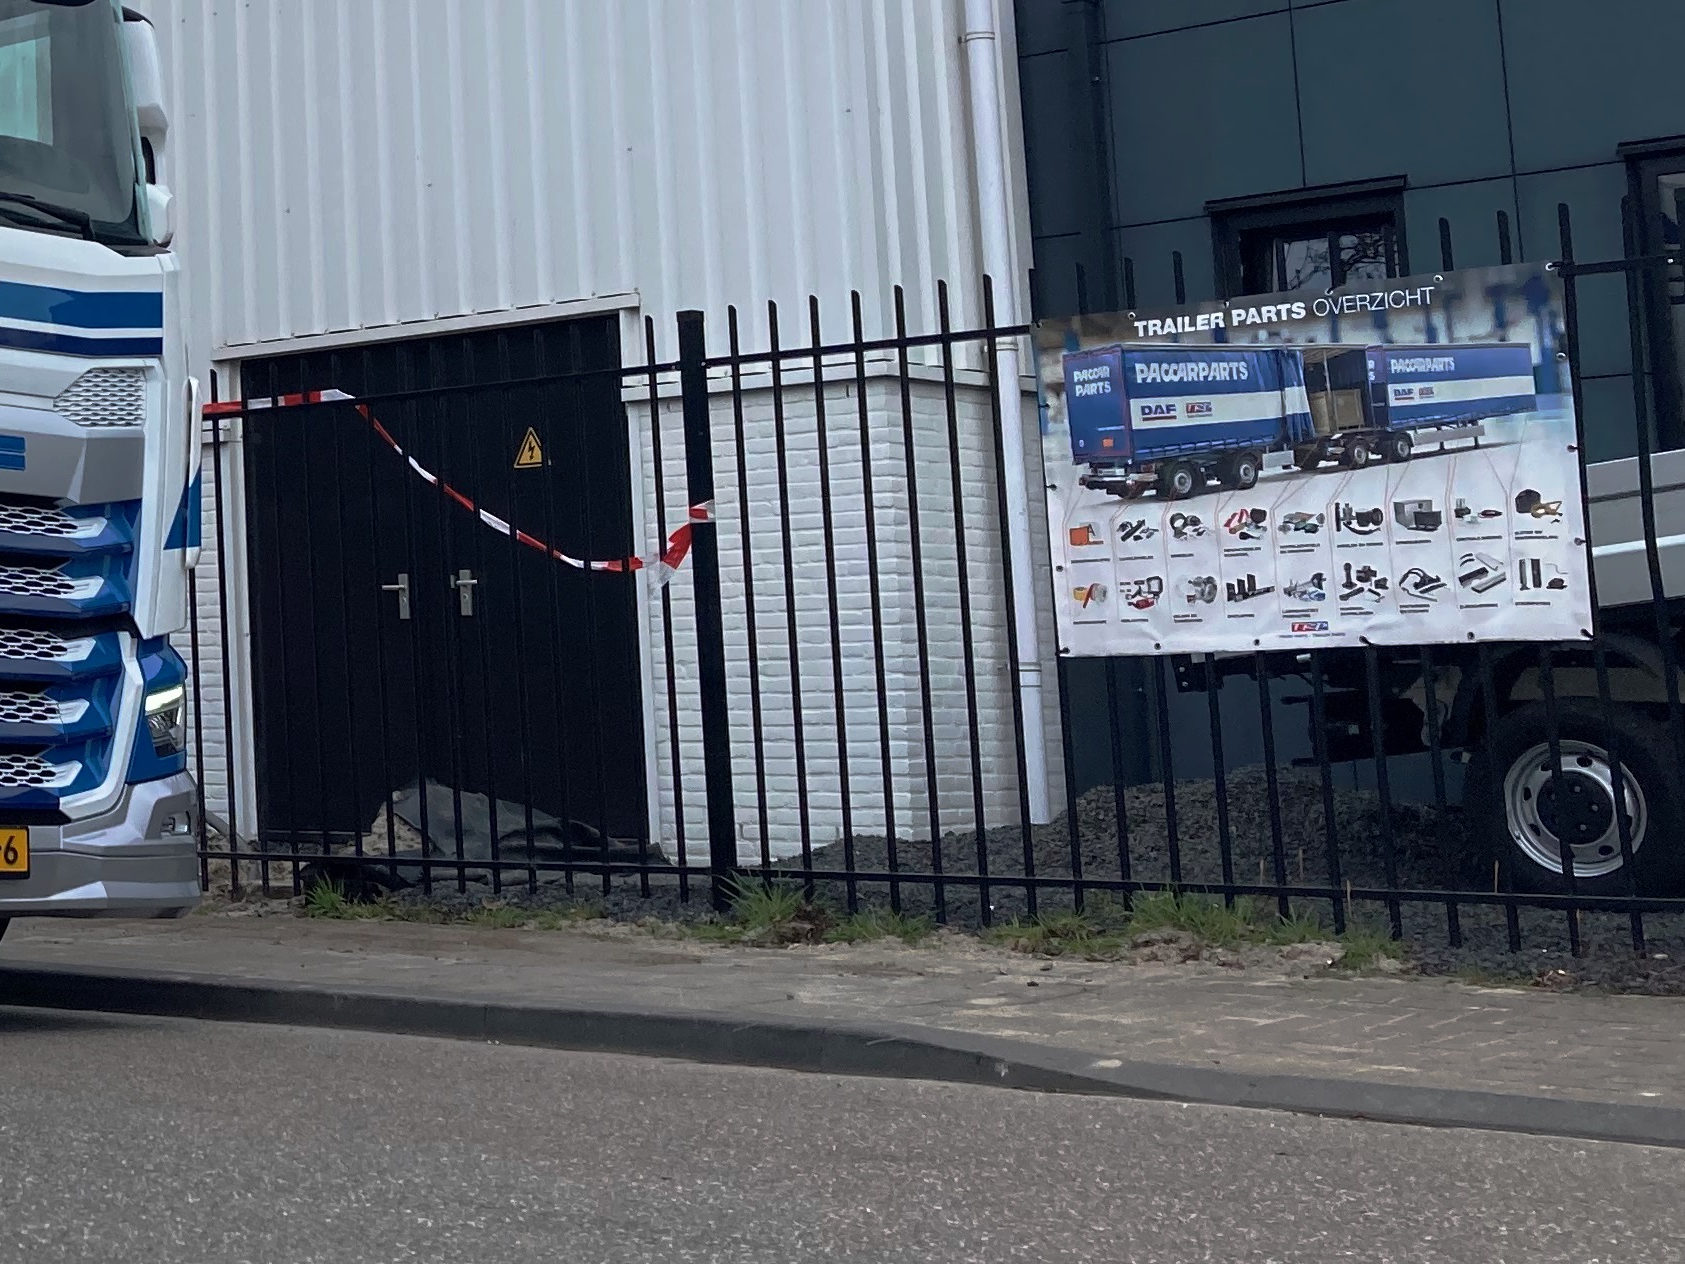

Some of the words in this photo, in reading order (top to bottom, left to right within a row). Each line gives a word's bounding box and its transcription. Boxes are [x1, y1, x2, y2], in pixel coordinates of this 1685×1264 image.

[1133, 311, 1226, 338] TRAILER
[1231, 301, 1306, 327] PARTS
[1313, 286, 1435, 318] OVERZICHT
[1072, 365, 1111, 383] PACCAR
[1075, 381, 1112, 397] PARTS
[1140, 403, 1178, 416] DAF
